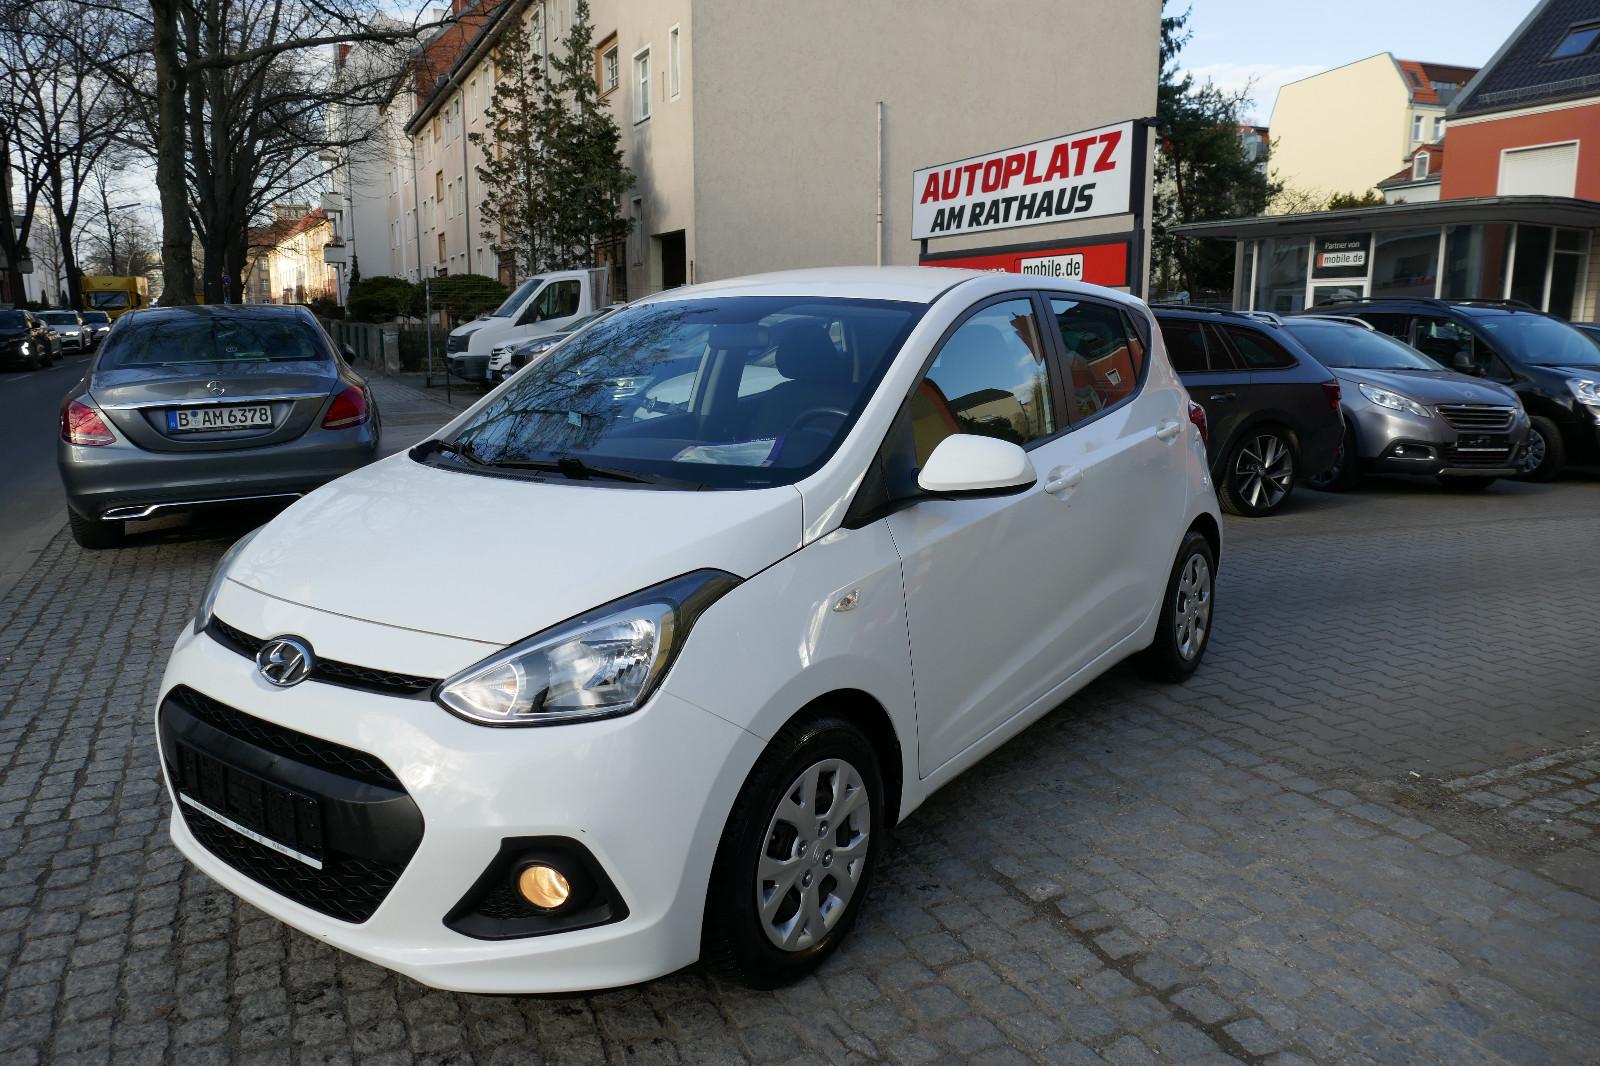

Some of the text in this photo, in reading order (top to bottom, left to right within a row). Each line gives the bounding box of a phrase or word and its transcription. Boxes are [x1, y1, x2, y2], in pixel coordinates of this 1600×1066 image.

[920, 130, 1122, 204] AUTOPLATZ
[930, 183, 1096, 232] AM RATHAUS
[1324, 242, 1347, 250] Partner
[1023, 258, 1081, 277] mobile.de
[1324, 253, 1363, 264] mobile.de
[178, 407, 269, 427] B AM 6378
